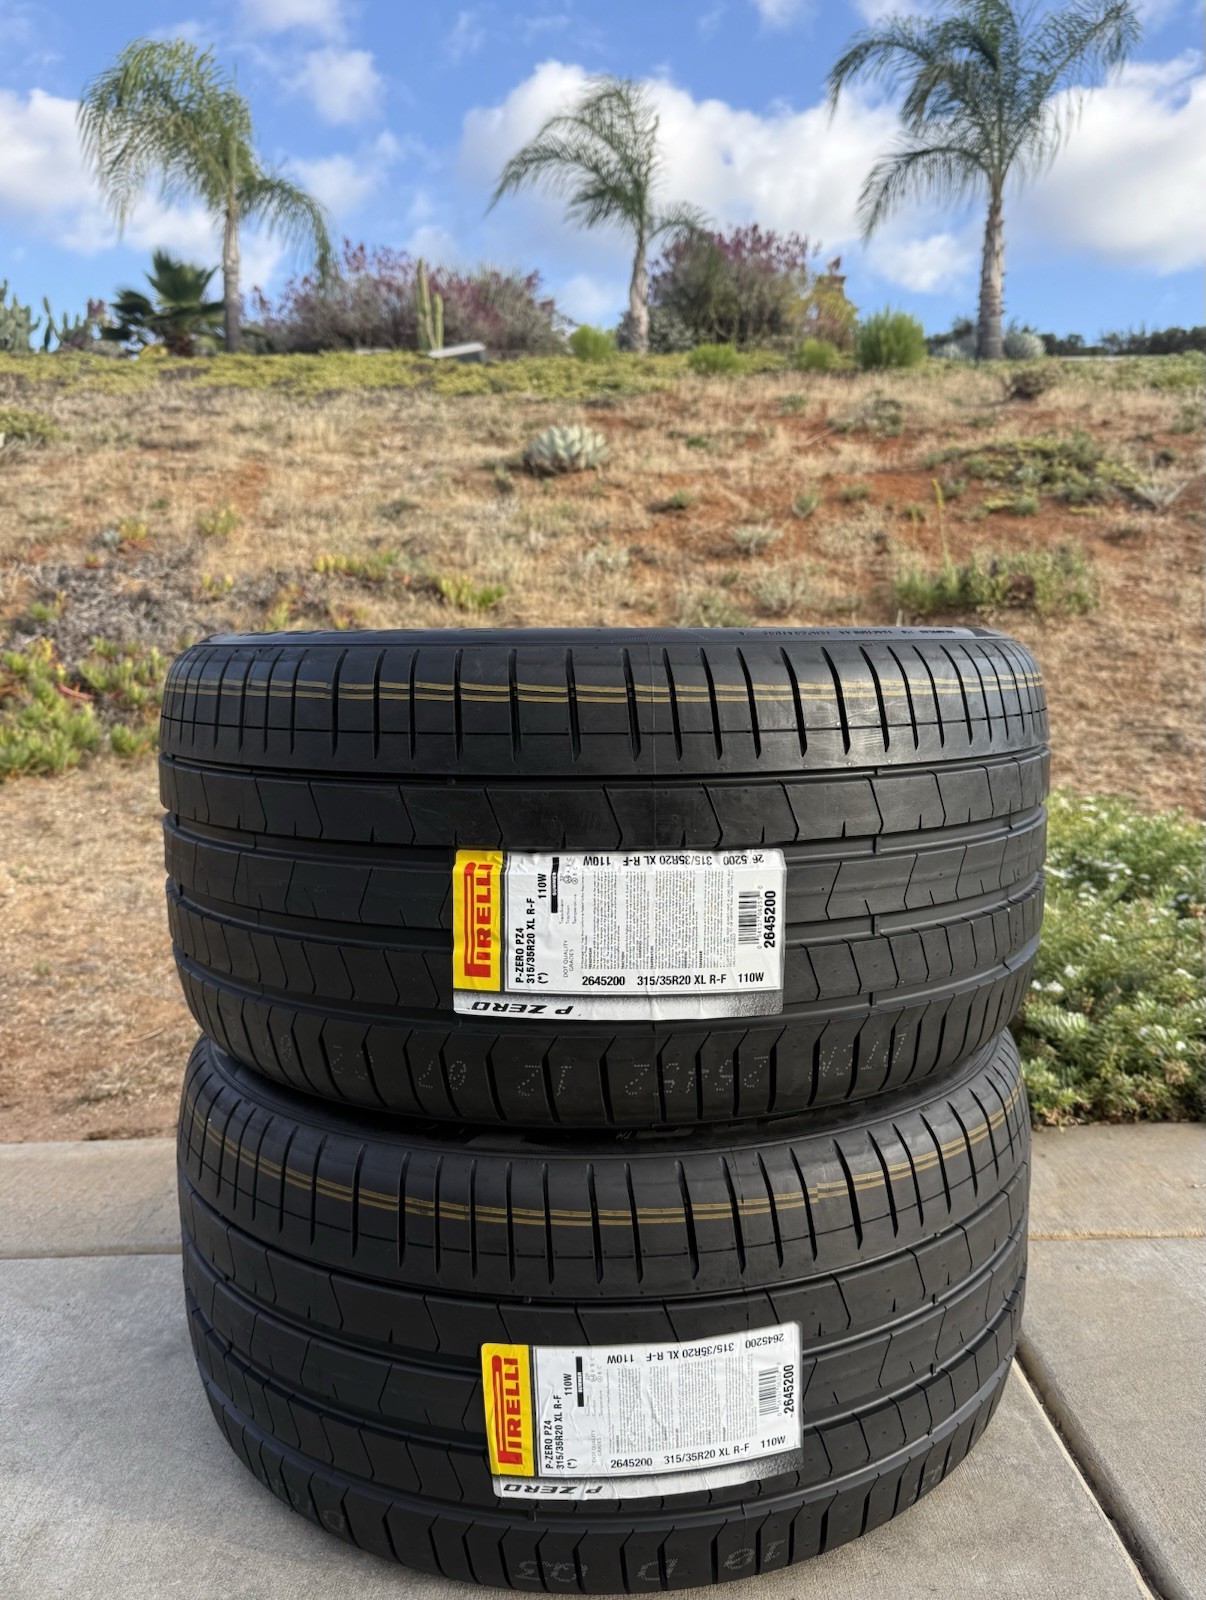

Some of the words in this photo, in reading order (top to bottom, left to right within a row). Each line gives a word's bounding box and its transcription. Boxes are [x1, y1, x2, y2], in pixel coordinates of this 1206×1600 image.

[583, 854, 611, 866] 110W
[623, 855, 641, 865] R-F
[643, 855, 656, 864] XL
[659, 854, 713, 865] 315/35R20
[537, 873, 547, 899] 110W
[526, 897, 536, 915] R-F
[464, 862, 493, 978] PIRELLI
[526, 918, 536, 930] XL
[764, 891, 776, 948] 2645200
[515, 927, 525, 945] PZ4
[515, 948, 525, 984] P-ZERO
[526, 933, 536, 984] 315/35R20
[582, 976, 626, 986] 2645200
[637, 974, 691, 986] 315/35R20
[694, 974, 707, 985] XL
[709, 974, 727, 985] R-F
[738, 972, 764, 983] 110W
[472, 1001, 546, 1013] ZERO
[555, 1005, 574, 1014] P
[745, 1333, 784, 1349] 2645200
[606, 1353, 634, 1364] 110W
[646, 1351, 664, 1362] R-F
[665, 1349, 680, 1359] XL
[682, 1342, 734, 1359] 315/35R20
[563, 1373, 573, 1396] 110W
[783, 1365, 794, 1413] 2645200
[553, 1394, 563, 1410] R-F
[492, 1355, 523, 1466] PIRELLI
[553, 1411, 563, 1422] XL
[543, 1419, 553, 1436] PZ4
[544, 1438, 554, 1470] P-ZERO
[554, 1424, 565, 1470] 315/35R20
[610, 1457, 653, 1469] 2645200
[664, 1450, 716, 1465] 315/35R20
[719, 1447, 731, 1458] XL
[733, 1443, 750, 1455] R-F
[760, 1436, 786, 1449] 110W
[503, 1484, 579, 1494] ZERO
[585, 1485, 603, 1494] P
